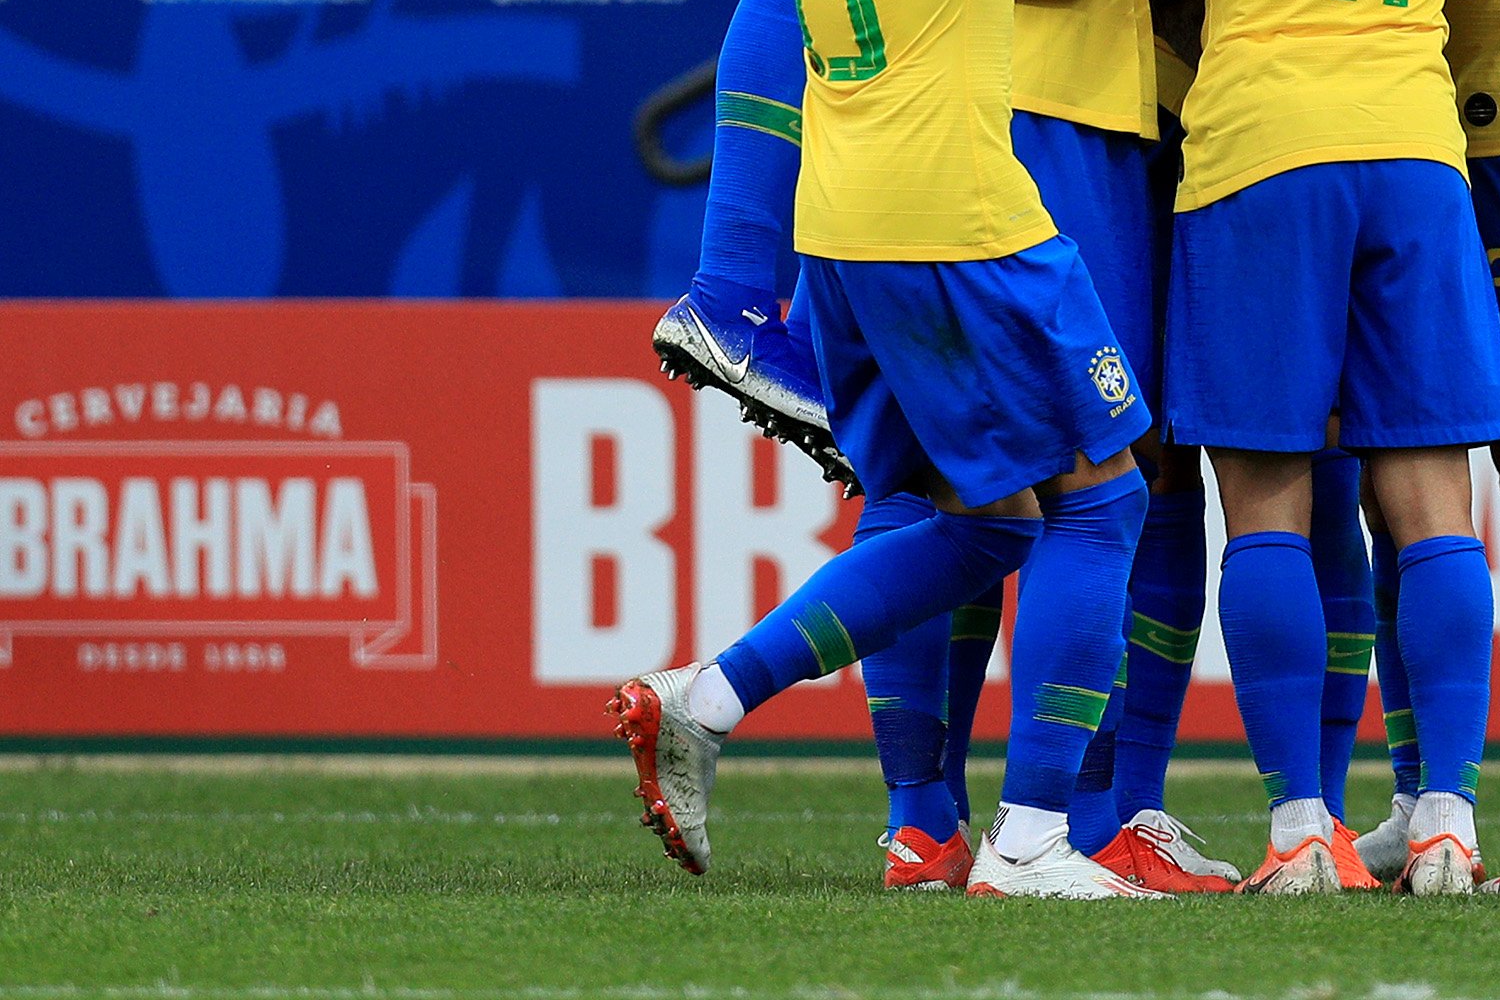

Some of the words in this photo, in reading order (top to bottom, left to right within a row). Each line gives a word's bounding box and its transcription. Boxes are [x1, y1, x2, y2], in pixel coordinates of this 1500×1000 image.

[14, 382, 344, 439] CERVEJARIA
[1109, 393, 1137, 418] BRASIL
[0, 477, 379, 599] BRAHMA
